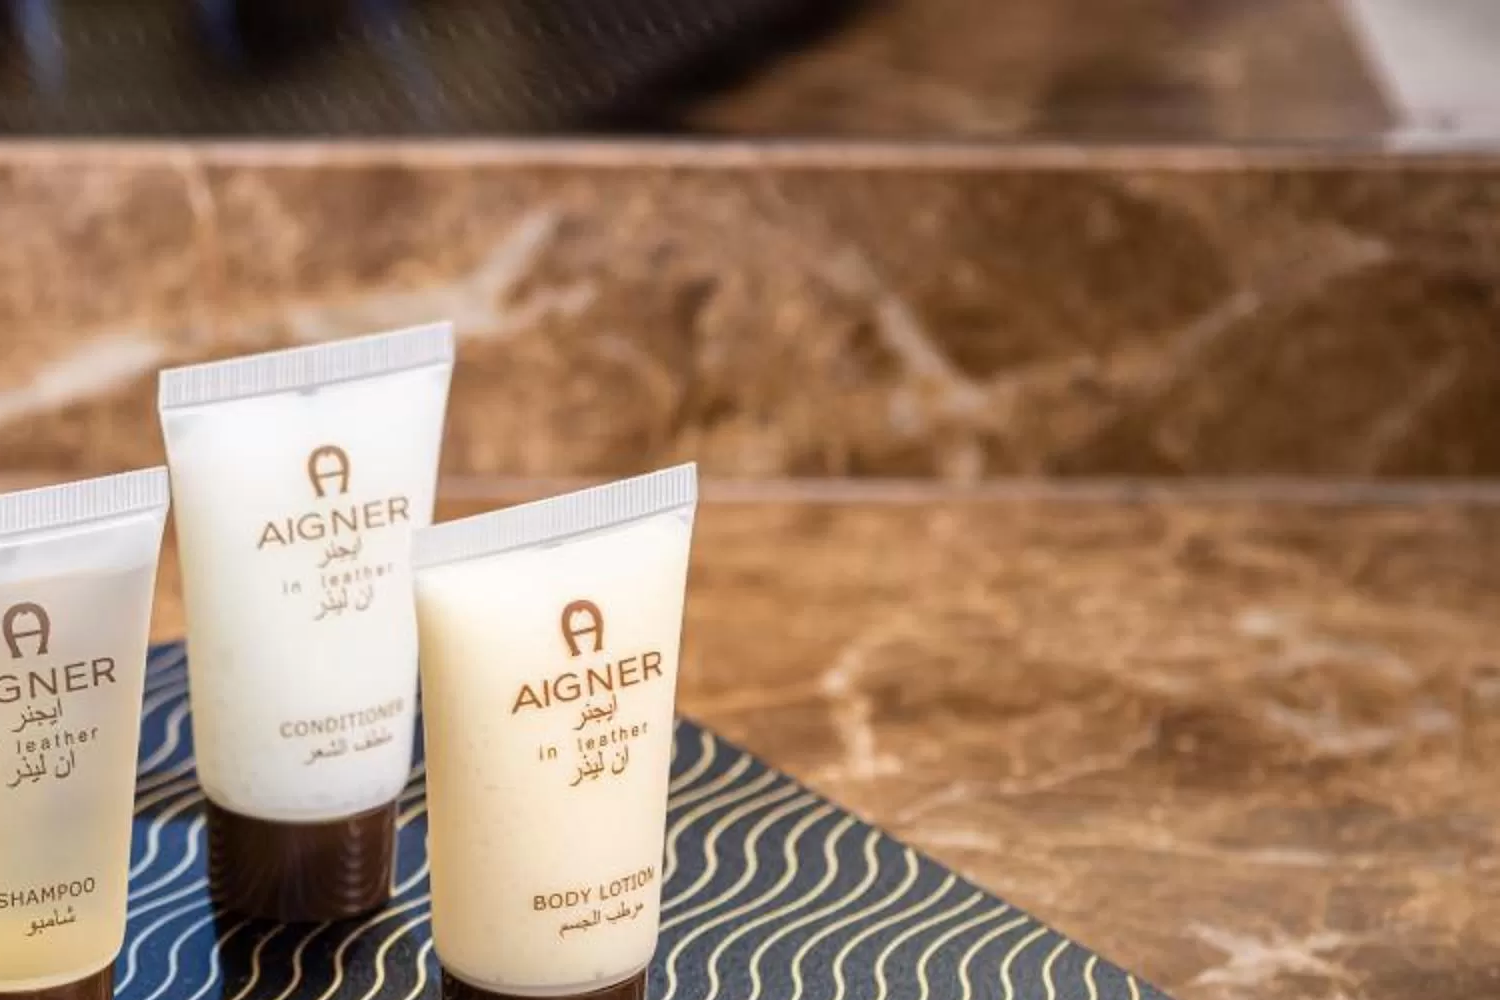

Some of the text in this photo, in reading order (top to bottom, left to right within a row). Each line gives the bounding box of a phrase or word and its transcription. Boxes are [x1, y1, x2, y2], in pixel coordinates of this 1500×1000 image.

[257, 496, 410, 550] AIGNER
[282, 562, 394, 596] in leather
[511, 650, 663, 715] AIGNER
[16, 726, 98, 756] leather
[539, 721, 649, 761] in leather
[533, 864, 655, 912] BODY LOTION
